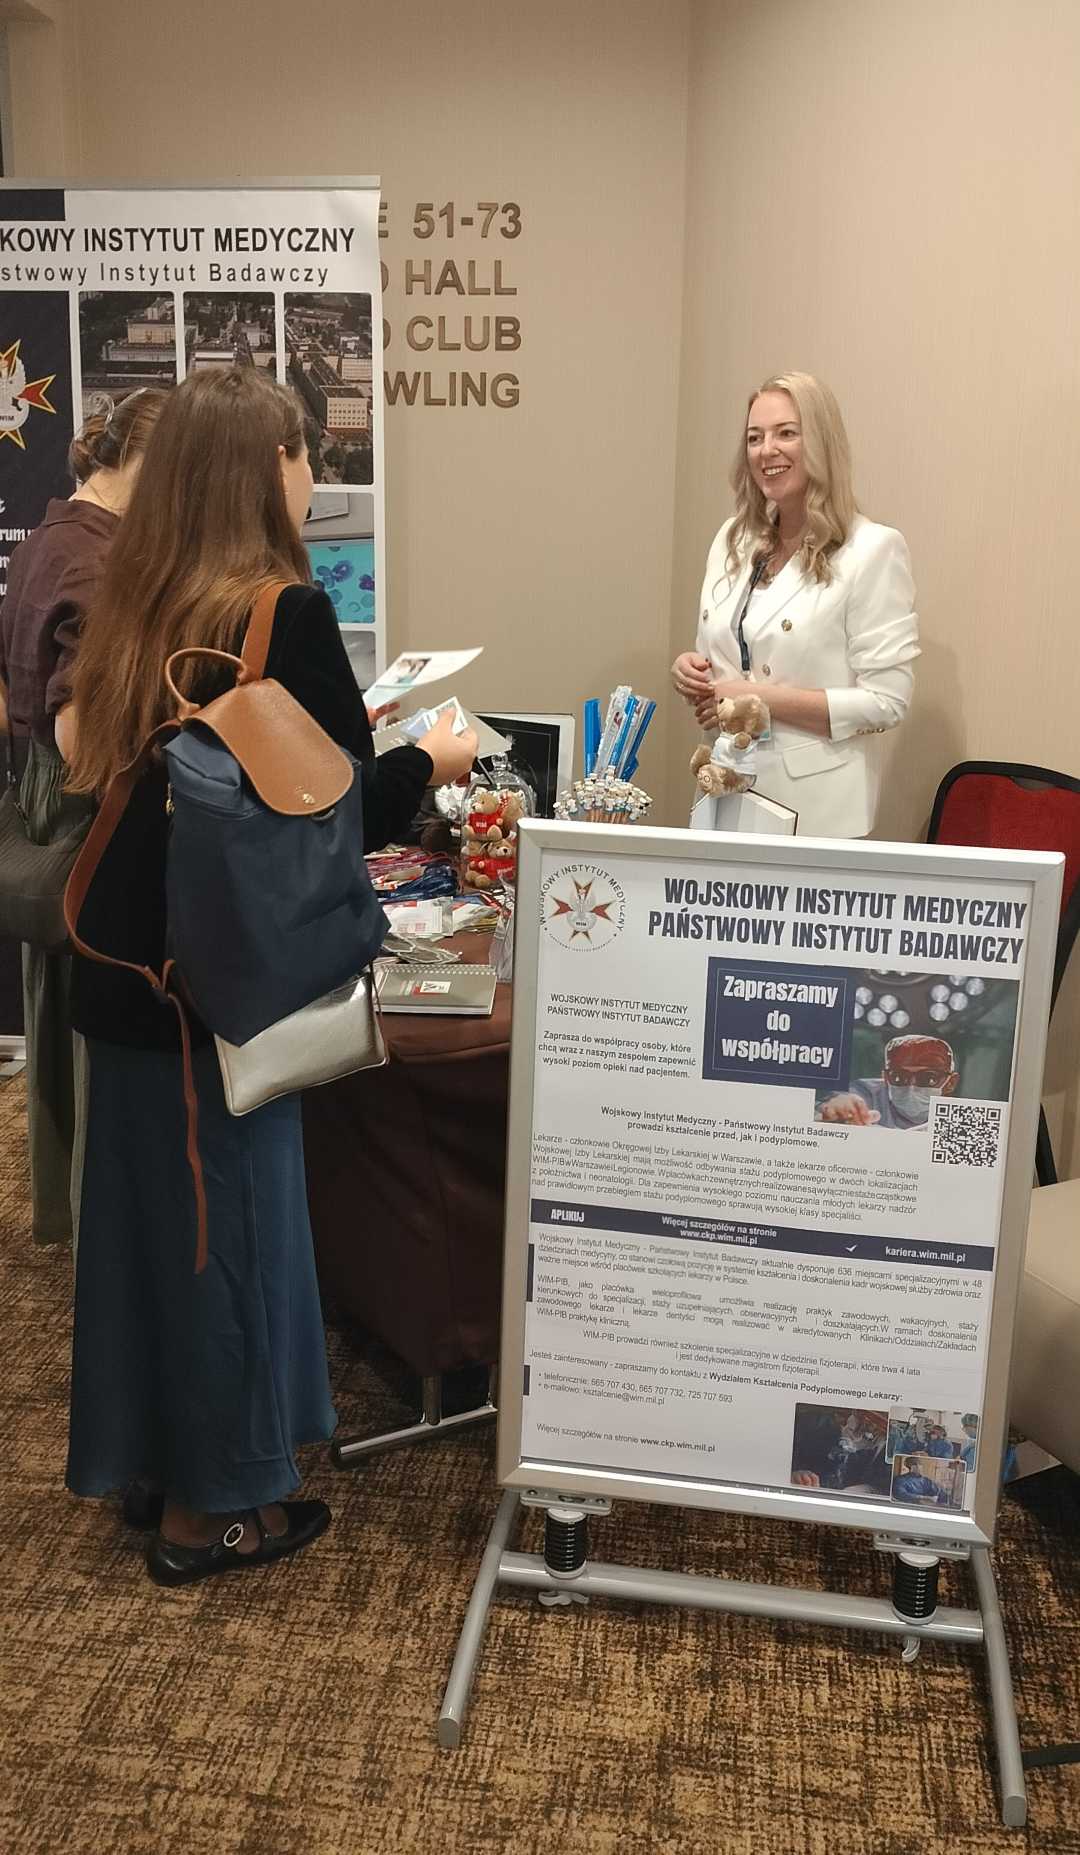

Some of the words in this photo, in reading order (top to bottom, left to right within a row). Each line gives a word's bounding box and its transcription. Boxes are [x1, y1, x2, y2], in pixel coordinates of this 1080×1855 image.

[413, 202, 522, 239] 51-73
[84, 228, 205, 252] INSTYTUT
[214, 228, 354, 252] MEDYCZNY
[100, 262, 196, 286] Instytut
[209, 263, 328, 287] Badawczy
[405, 259, 518, 295] HALL
[406, 316, 522, 351] CLUB
[664, 878, 789, 912] WOJSKOWY
[796, 887, 896, 920] INSTYTUT
[903, 895, 1028, 929] MEDYCZNY
[648, 907, 785, 945] PAŃSTWOWY
[792, 922, 893, 954] INSTYTUT
[899, 931, 1025, 964] BADAWCZY
[723, 975, 839, 1008] Zapraszamy
[551, 994, 599, 1006] WOJSKOWY
[601, 998, 640, 1010] INSTYTUT
[642, 1002, 688, 1014] MEDYCZNY
[548, 1005, 600, 1018] PAŃSTWOWY
[602, 1011, 641, 1022] INSTYTUT
[643, 1015, 690, 1027] BADAWCZY
[766, 1009, 791, 1032] do
[544, 1031, 579, 1042] Zaprasza
[671, 1043, 691, 1053] które
[560, 1046, 578, 1054] wraz
[586, 1049, 616, 1059] naszym
[721, 1037, 834, 1068] współpracy
[543, 1057, 570, 1066] wysoki
[573, 1060, 601, 1069] poziom
[603, 1063, 627, 1072] opieki
[629, 1065, 644, 1073] nad
[601, 1106, 641, 1120] Wojskowy
[644, 1111, 675, 1122] Instytut
[677, 1114, 716, 1127] Medyczny
[724, 1119, 770, 1133] Państwowy
[773, 1123, 804, 1135] Instytut
[807, 1127, 849, 1141] Badawczy
[627, 1122, 664, 1131] prowadzi
[740, 1132, 753, 1142] jak
[533, 1133, 562, 1143] Lekarze
[654, 1146, 669, 1156] Izby
[798, 1161, 825, 1171] lekarze
[575, 1149, 589, 1159] Izby
[639, 1178, 651, 1186] Dla
[746, 1192, 777, 1200] poziomu
[858, 1201, 886, 1213] lekarzy
[551, 1209, 585, 1222] APLIKUJ
[661, 1216, 688, 1228] Więcej
[749, 1227, 777, 1237] stronie
[680, 1230, 757, 1245] www.ckp.wim.mil.pl
[885, 1246, 966, 1264] kariera.wim.mil.pl
[800, 1383, 867, 1399] Podyplomowego
[869, 1391, 903, 1403] Lekarzy:
